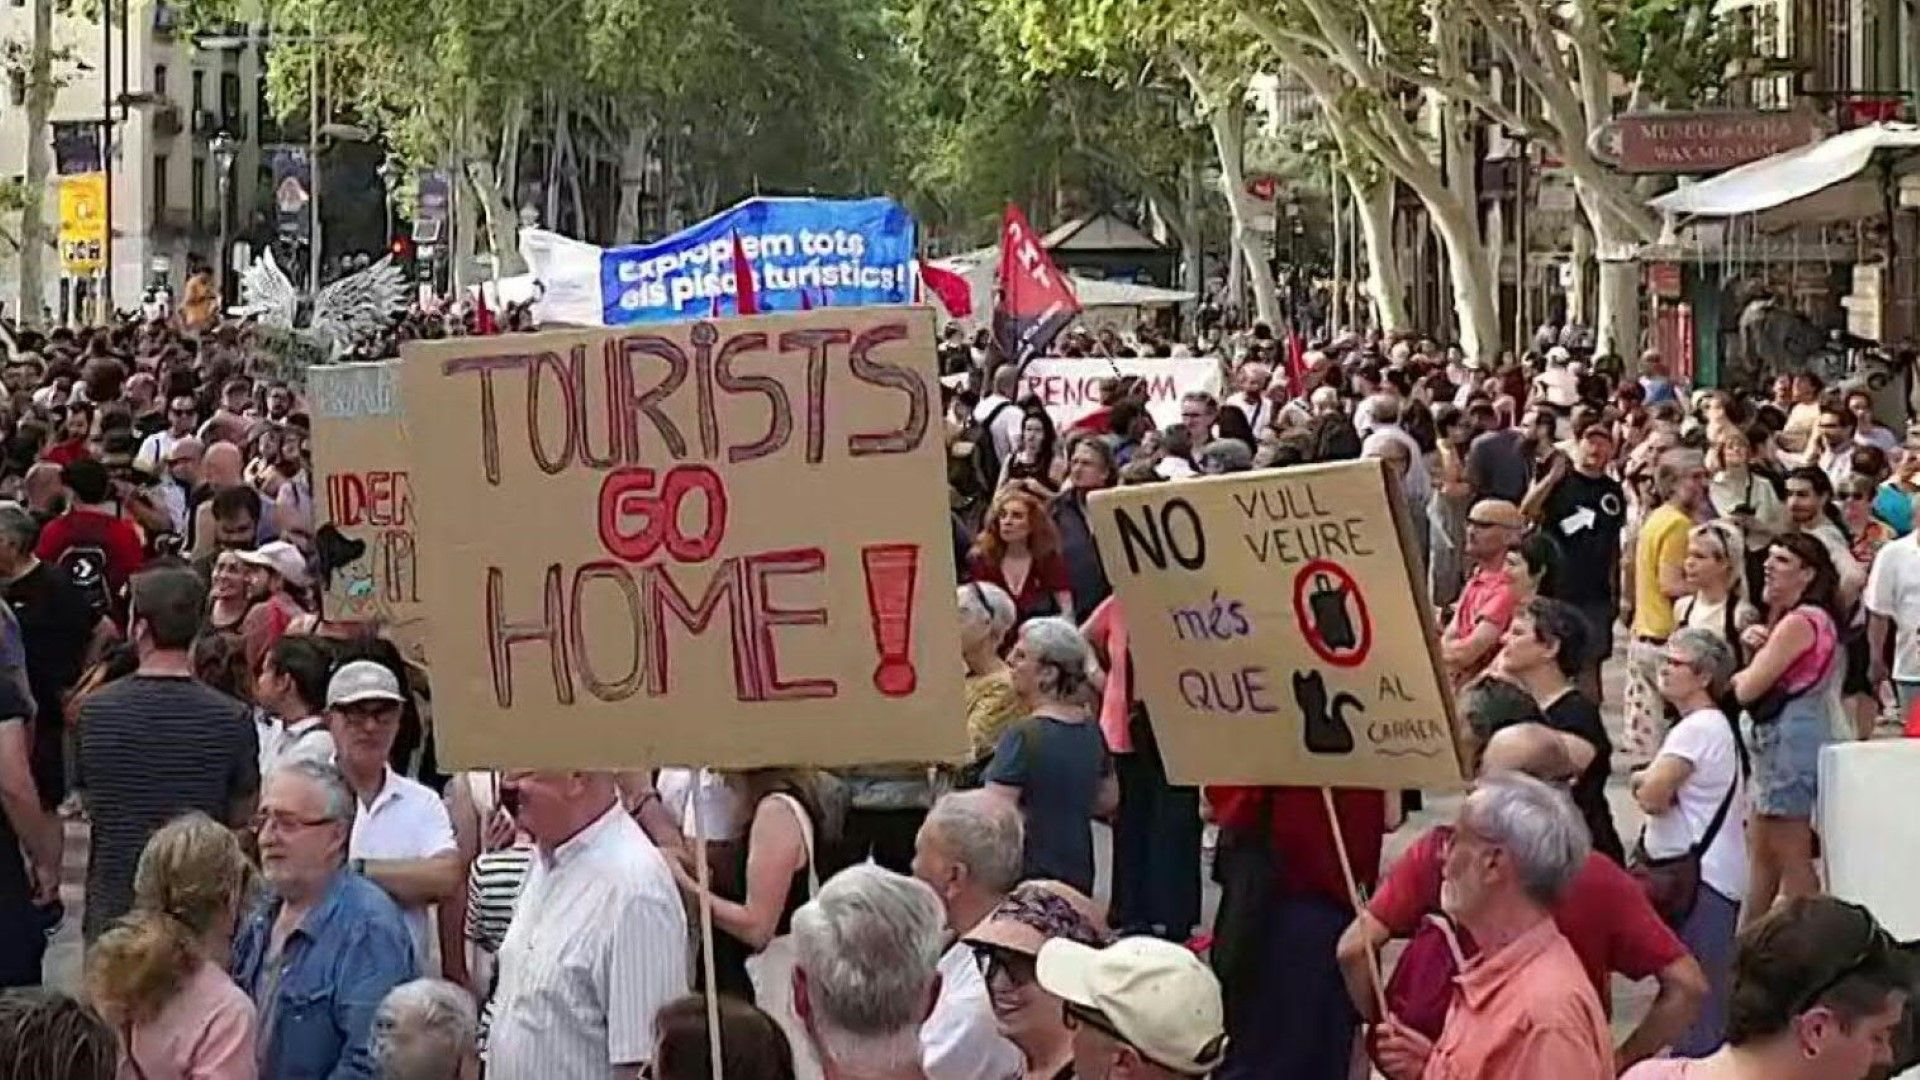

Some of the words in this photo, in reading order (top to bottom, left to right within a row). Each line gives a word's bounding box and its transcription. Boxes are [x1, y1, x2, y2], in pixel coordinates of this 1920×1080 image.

[802, 229, 864, 254] tots
[618, 280, 667, 308] els
[600, 463, 727, 563] GO
[1112, 497, 1206, 574] NO
[1233, 482, 1332, 521] VULL
[1244, 518, 1376, 563] VEURE
[1171, 589, 1250, 641] més
[1177, 667, 1280, 714] QUE
[1378, 674, 1416, 702] AL
